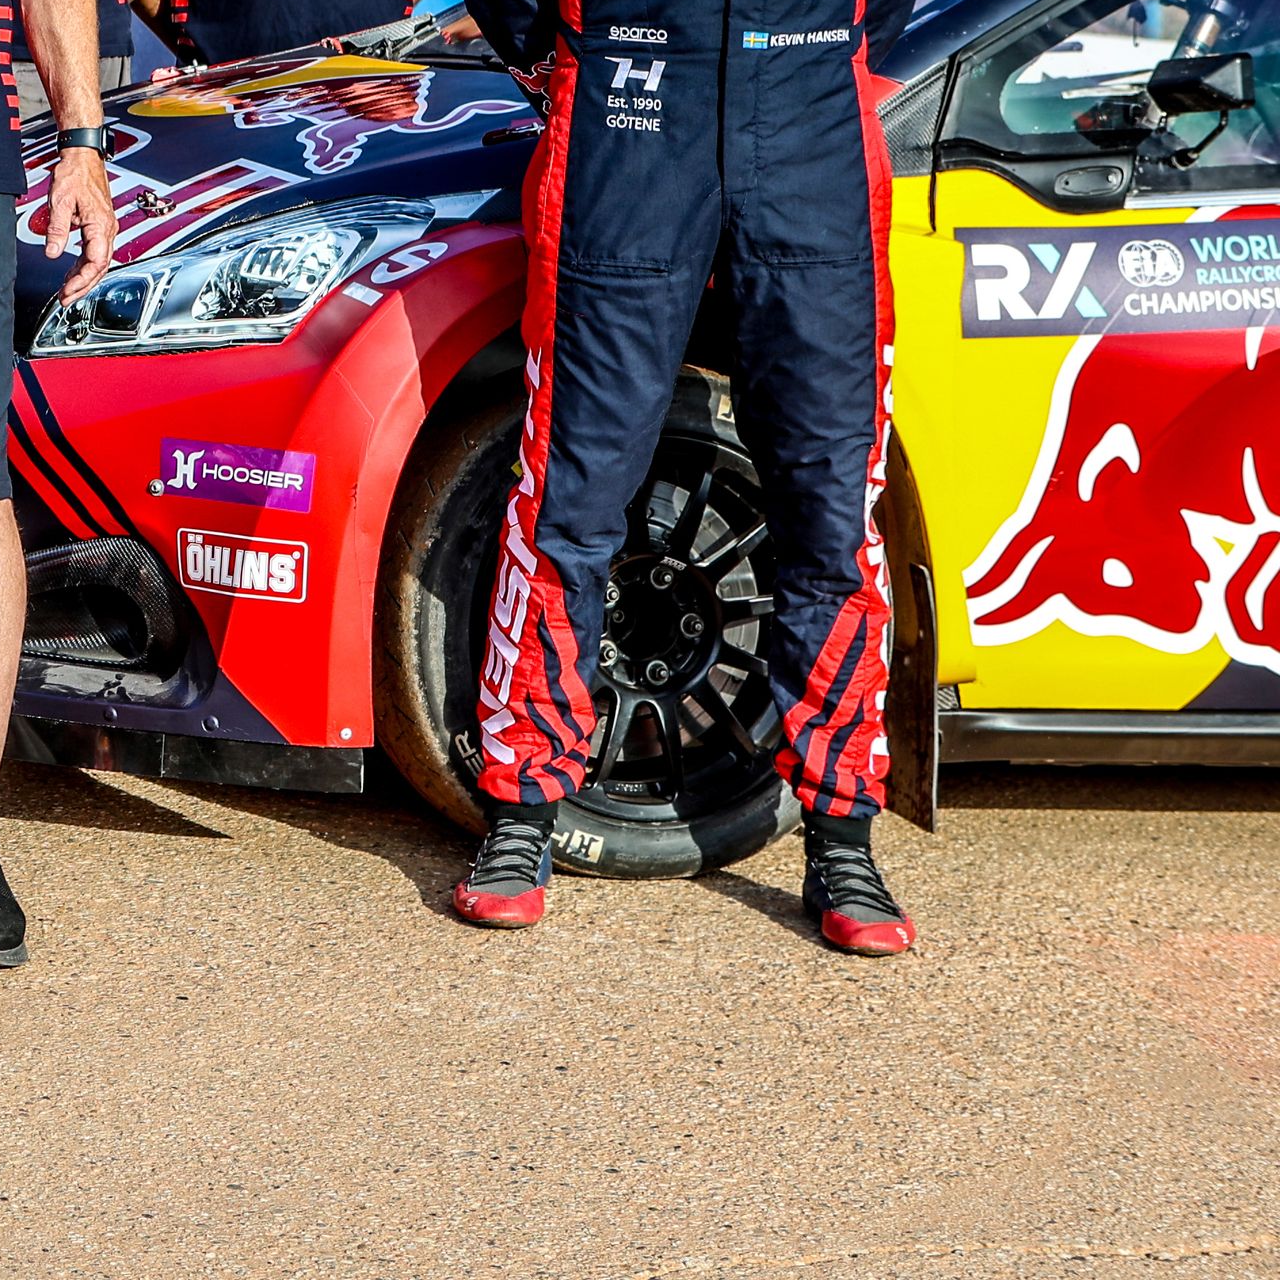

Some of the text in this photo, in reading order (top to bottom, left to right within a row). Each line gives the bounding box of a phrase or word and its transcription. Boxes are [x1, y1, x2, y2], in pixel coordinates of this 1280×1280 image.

[608, 24, 668, 44] sparco
[769, 28, 850, 48] KEVIN HANSEN
[607, 95, 662, 112] Est. 1990
[606, 113, 661, 132] GÖTENE
[1190, 233, 1280, 264] WORL
[970, 241, 1108, 320] RX
[202, 462, 304, 492] HOOSIER
[186, 533, 296, 594] ÖHLINS
